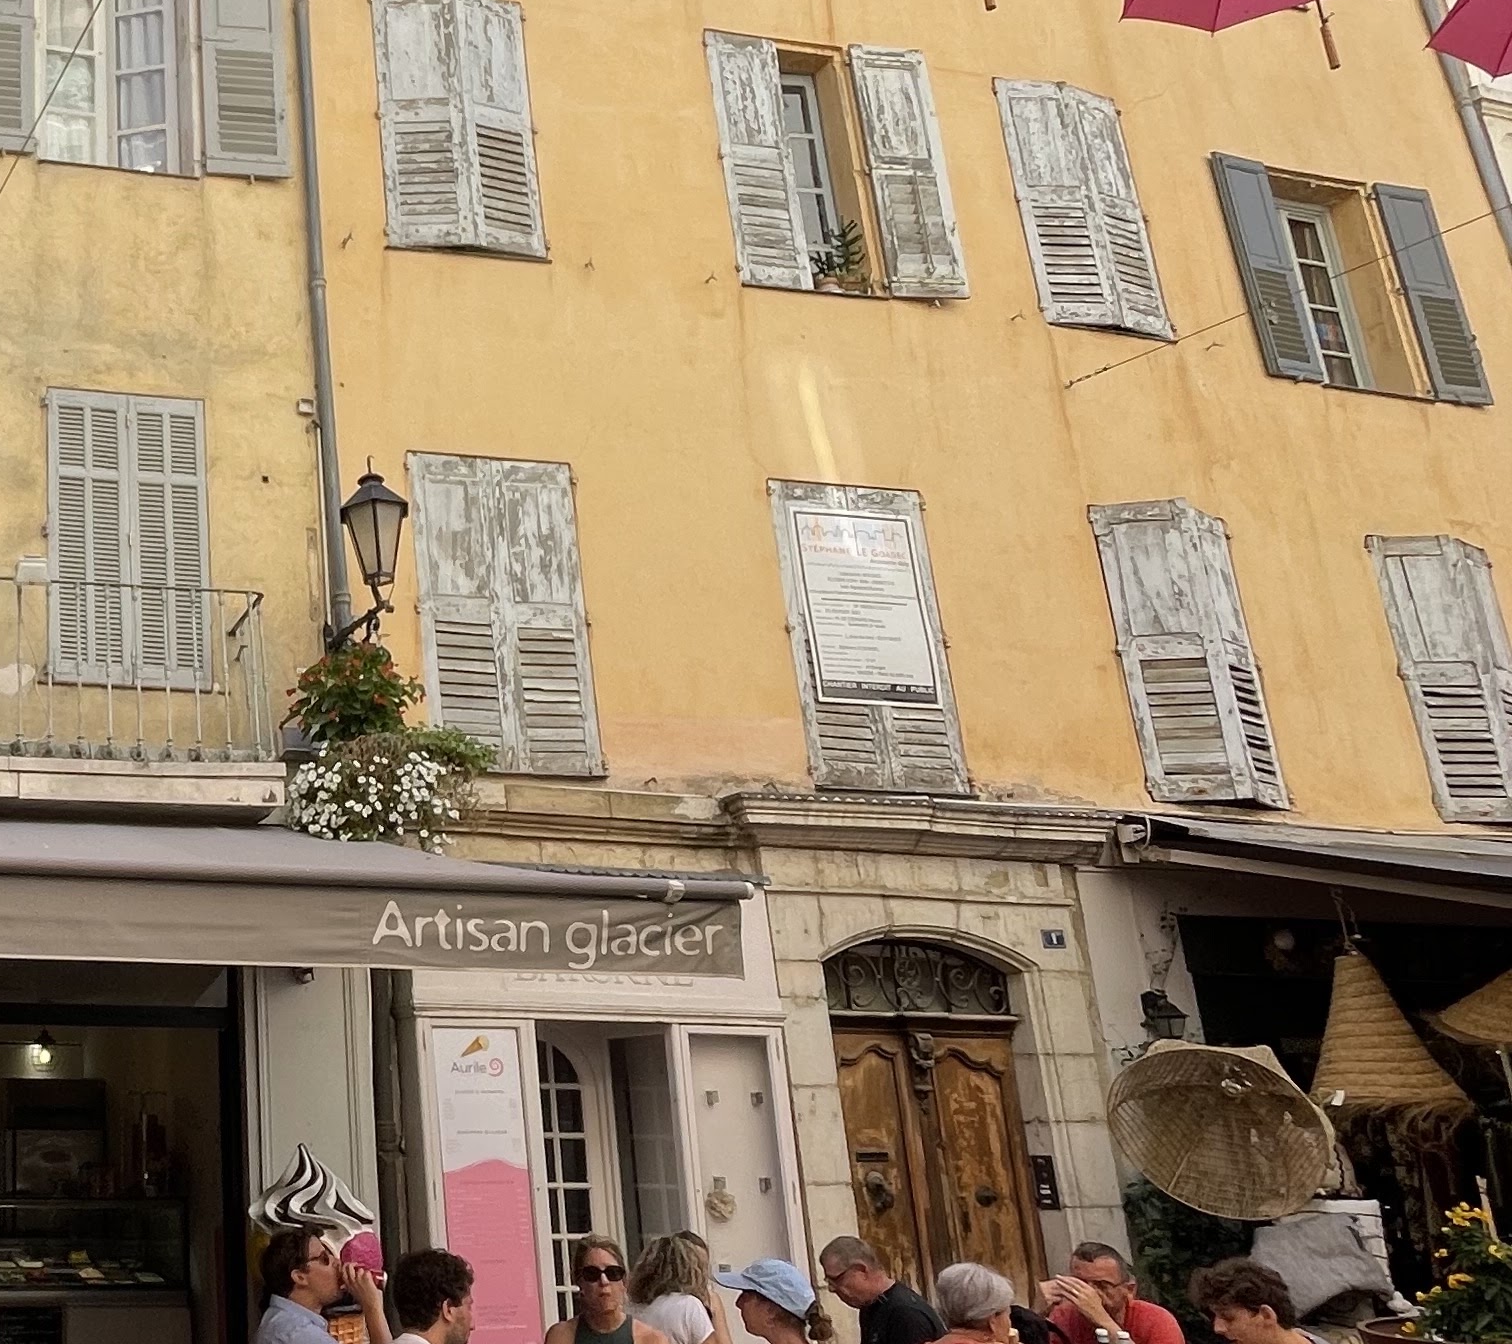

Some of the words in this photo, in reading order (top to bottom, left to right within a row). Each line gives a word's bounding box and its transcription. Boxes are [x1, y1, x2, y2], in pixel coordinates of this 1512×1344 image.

[372, 899, 550, 954] Artisan
[565, 909, 724, 970] glacier
[450, 1060, 487, 1074] Aurile
